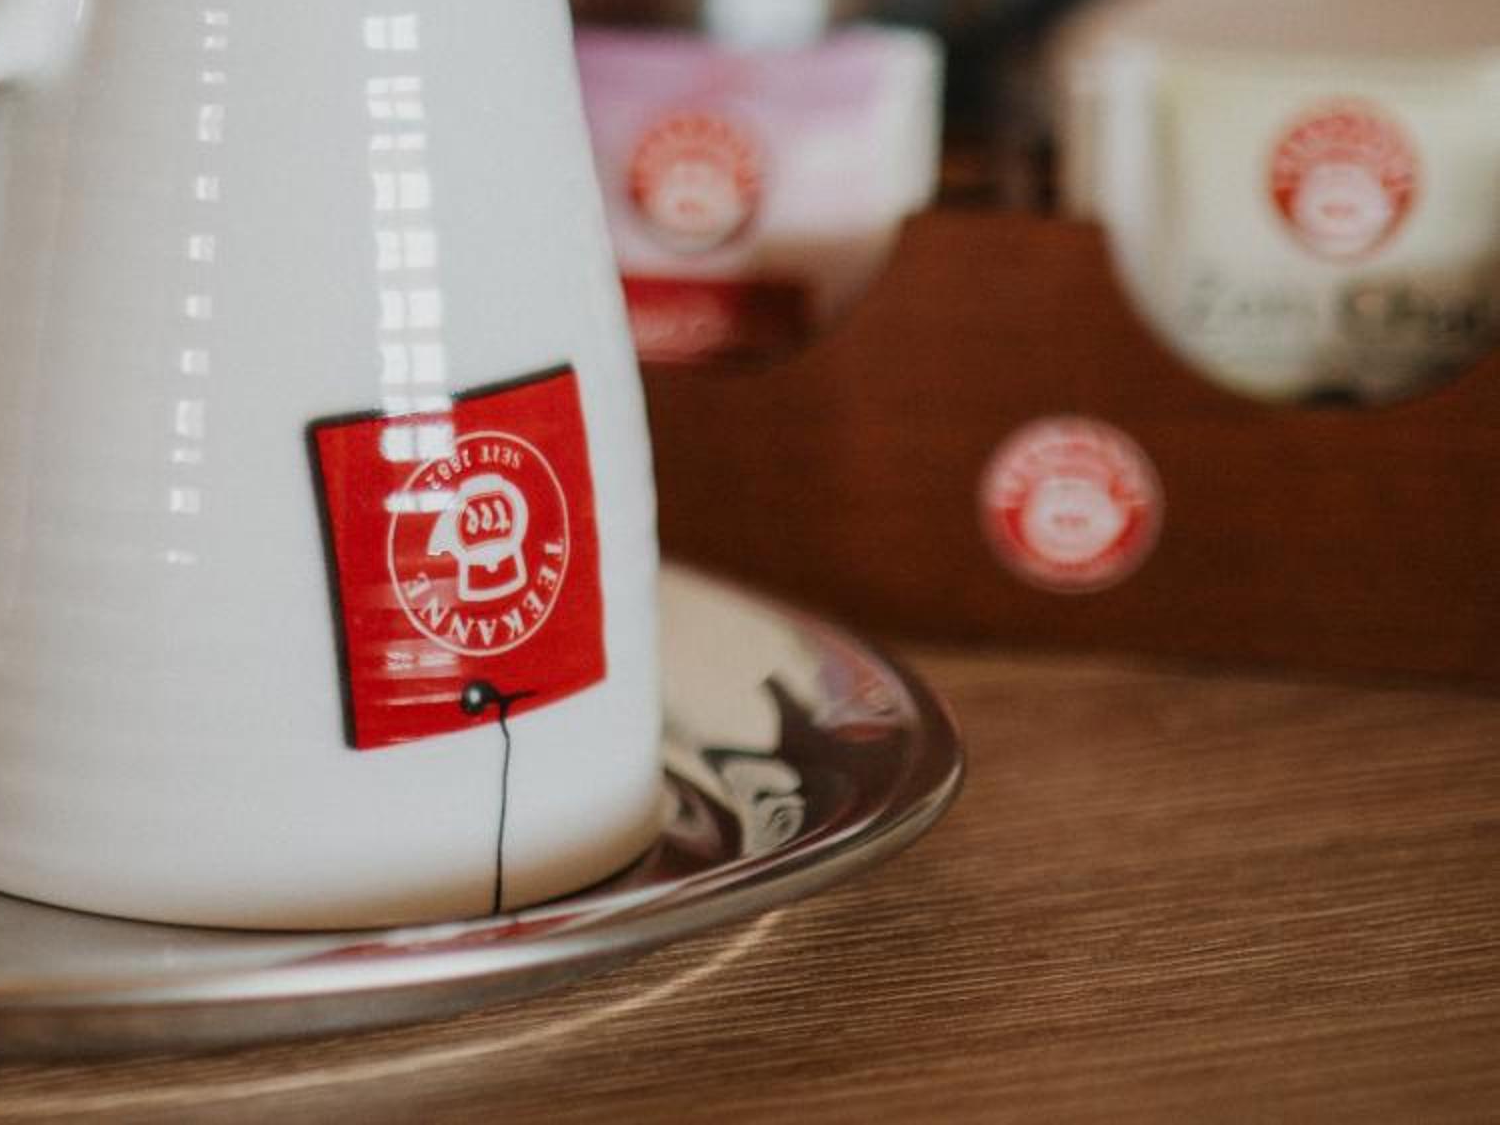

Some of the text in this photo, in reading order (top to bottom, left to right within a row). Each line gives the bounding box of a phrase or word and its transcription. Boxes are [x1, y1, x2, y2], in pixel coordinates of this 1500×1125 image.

[479, 444, 522, 469] SEIT
[464, 500, 512, 535] tee
[402, 538, 564, 646] TEEKANNE
